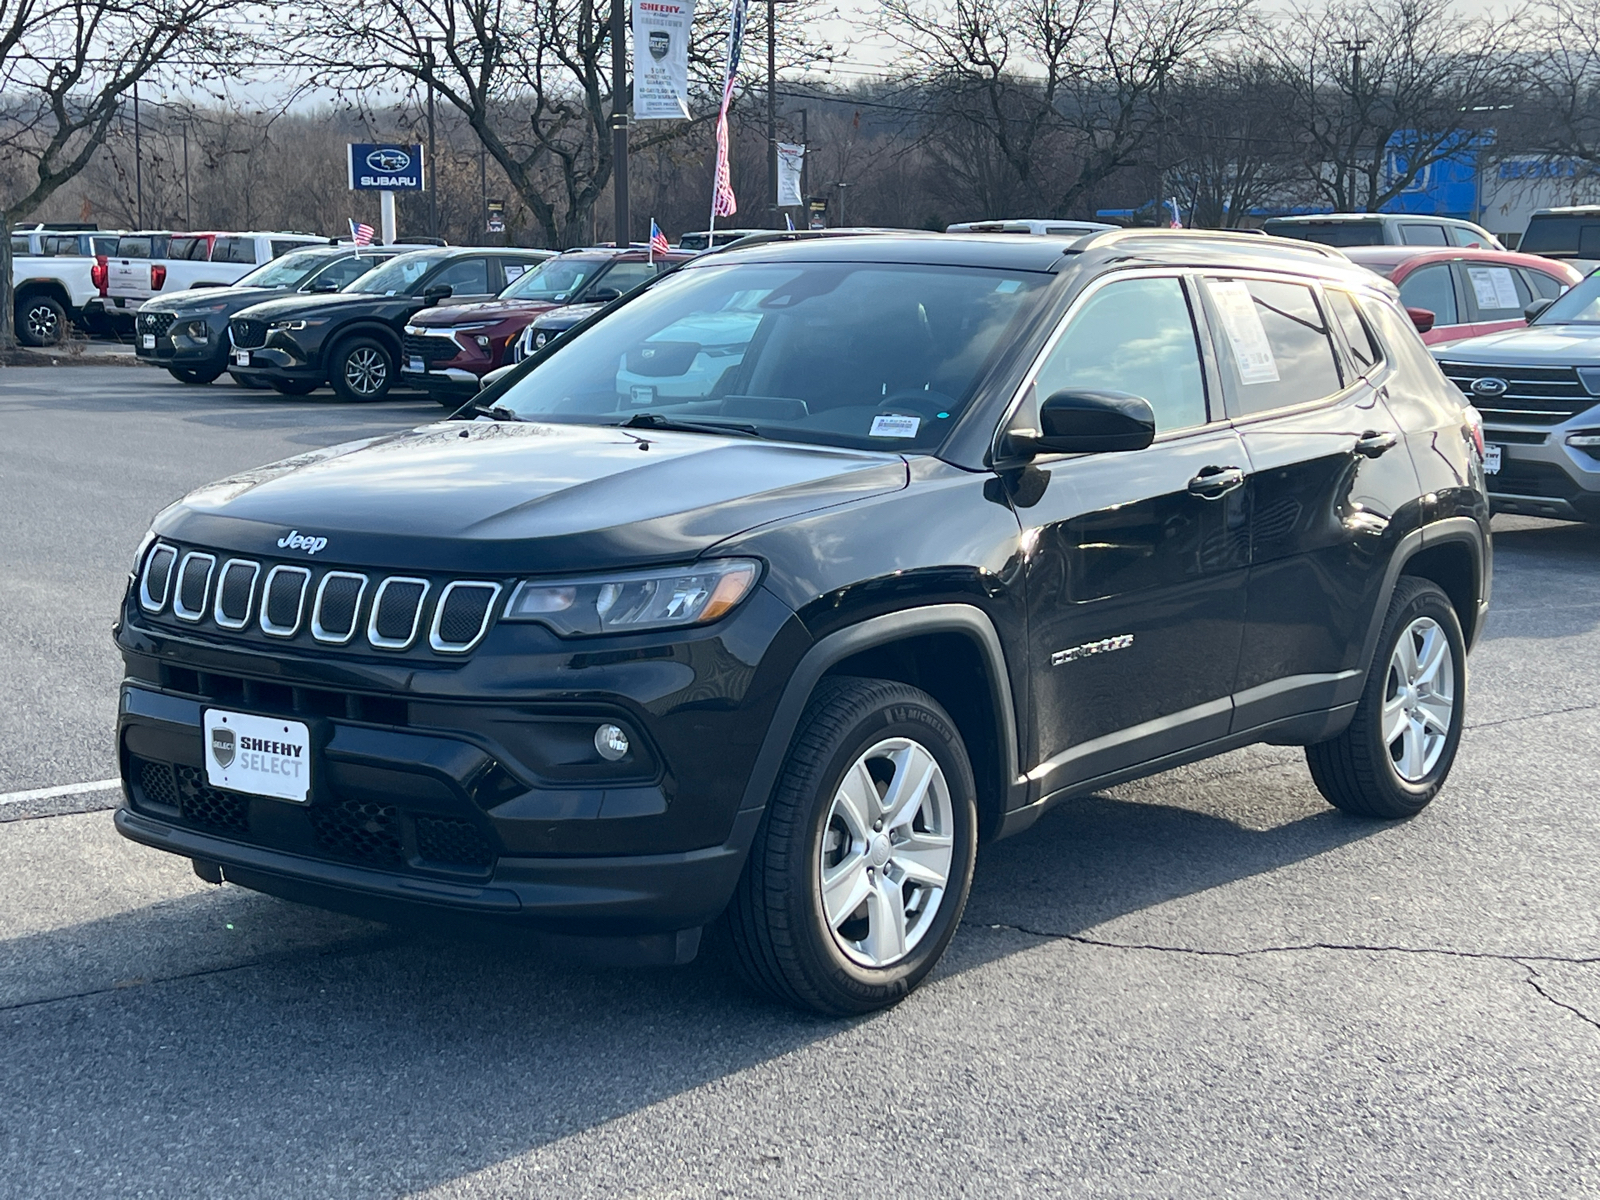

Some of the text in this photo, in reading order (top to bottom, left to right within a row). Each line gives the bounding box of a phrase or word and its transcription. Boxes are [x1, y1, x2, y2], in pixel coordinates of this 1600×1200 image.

[640, 2, 680, 13] SHEEHY
[360, 176, 417, 187] SUBARU
[277, 530, 328, 555] Jeep
[907, 709, 951, 741] MICHELIN
[213, 741, 234, 751] SELECT
[240, 736, 303, 758] SHEEHY
[240, 752, 303, 778] SELECT
